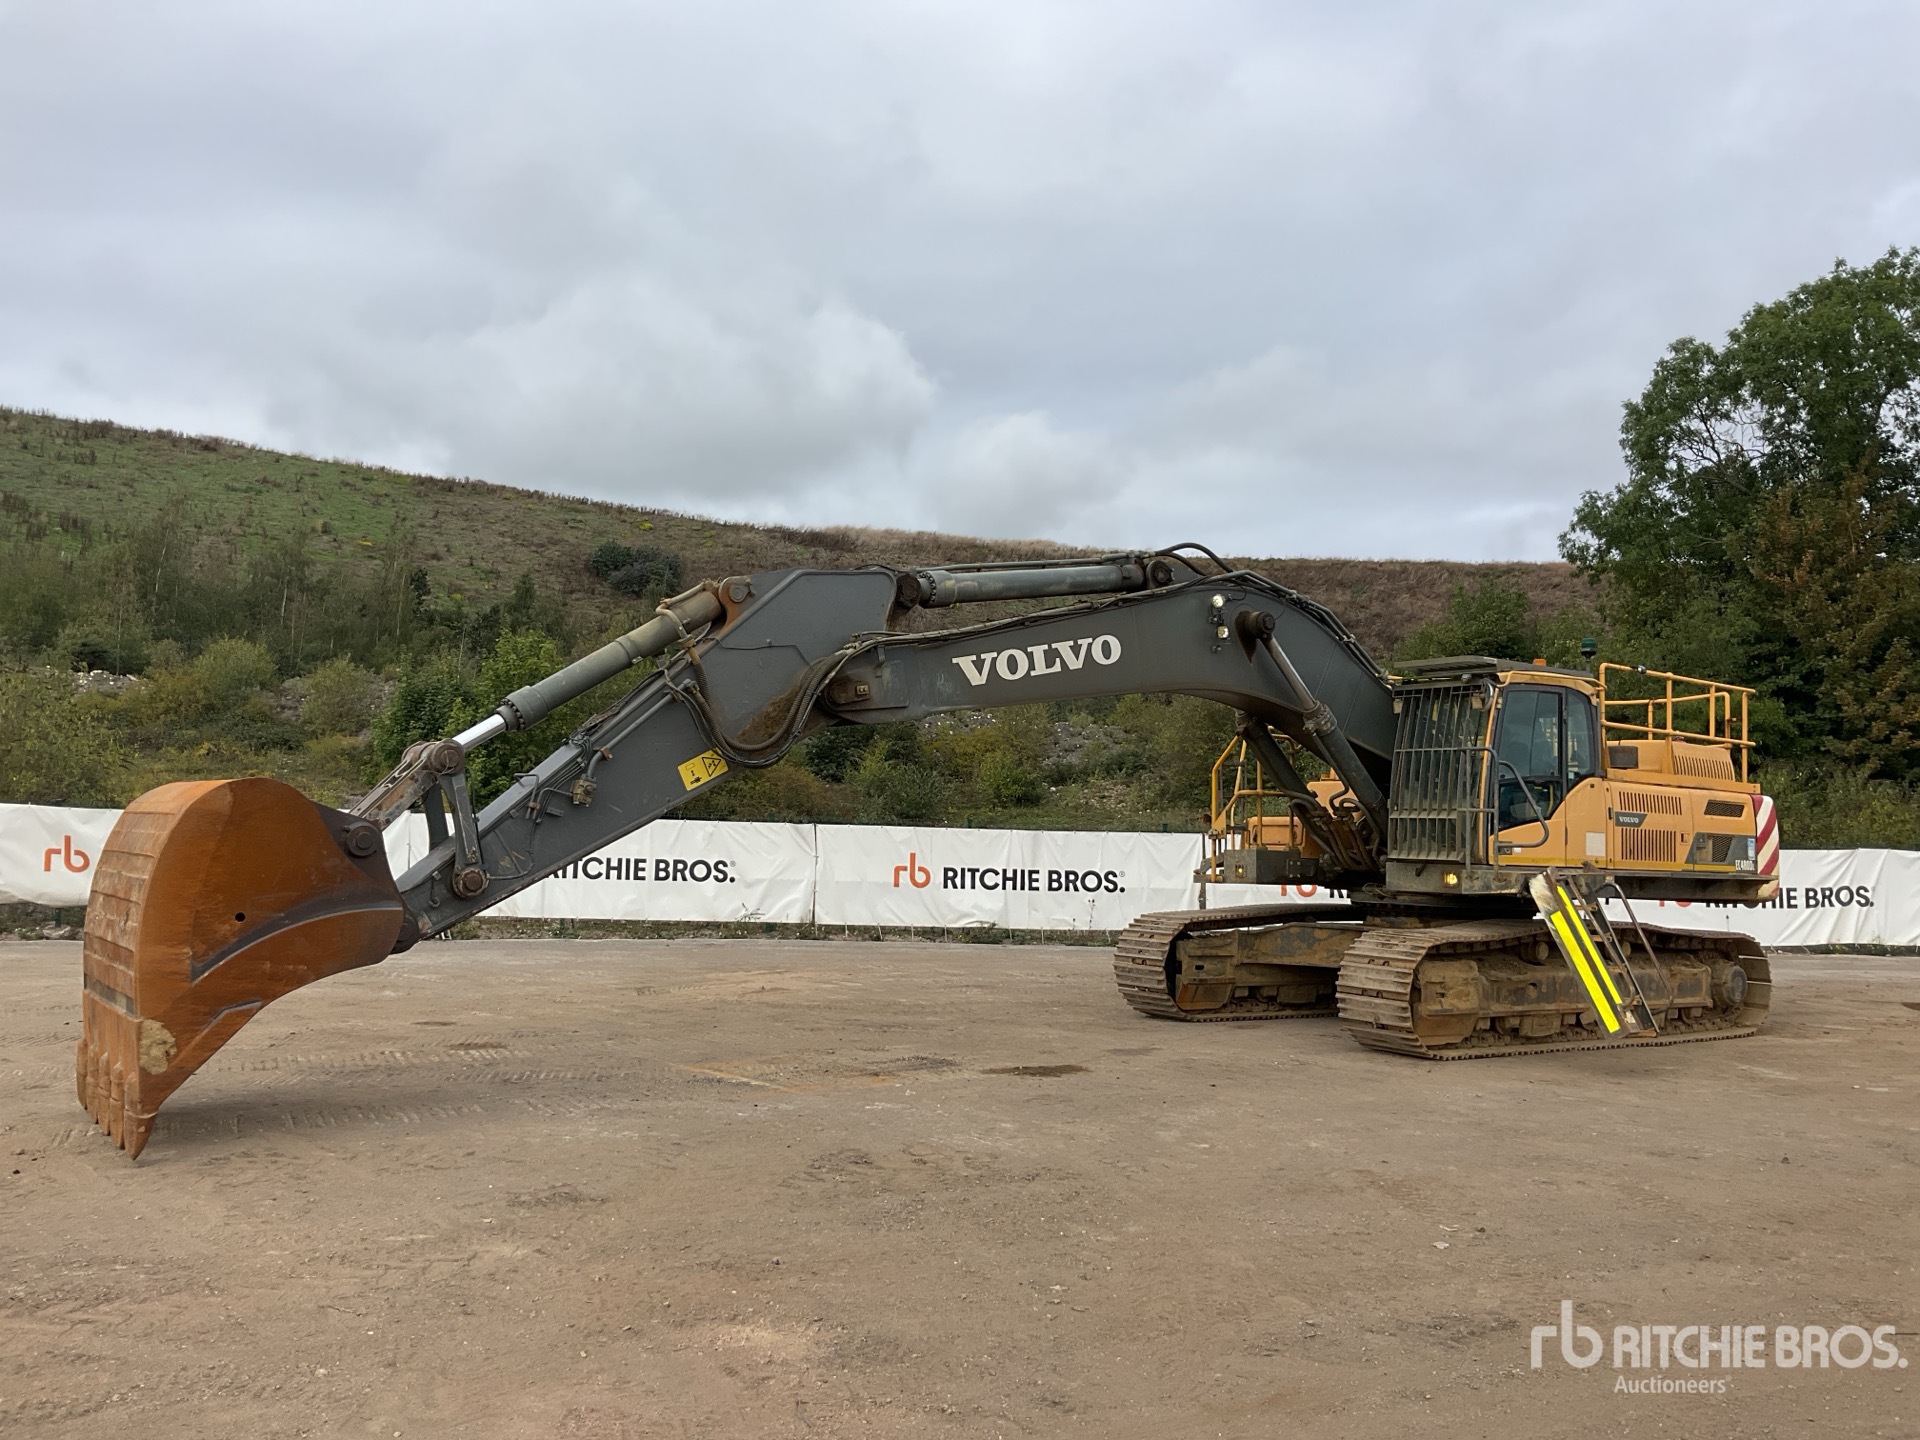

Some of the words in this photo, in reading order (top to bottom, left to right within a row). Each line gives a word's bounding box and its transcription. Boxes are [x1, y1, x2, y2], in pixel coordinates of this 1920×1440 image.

[952, 634, 1122, 686] VOLVO
[1618, 816, 1639, 824] VOLVO
[43, 834, 90, 873] rb
[893, 852, 931, 889] rb
[943, 867, 1040, 891] RITCHIE
[1804, 885, 1875, 909] BROS.
